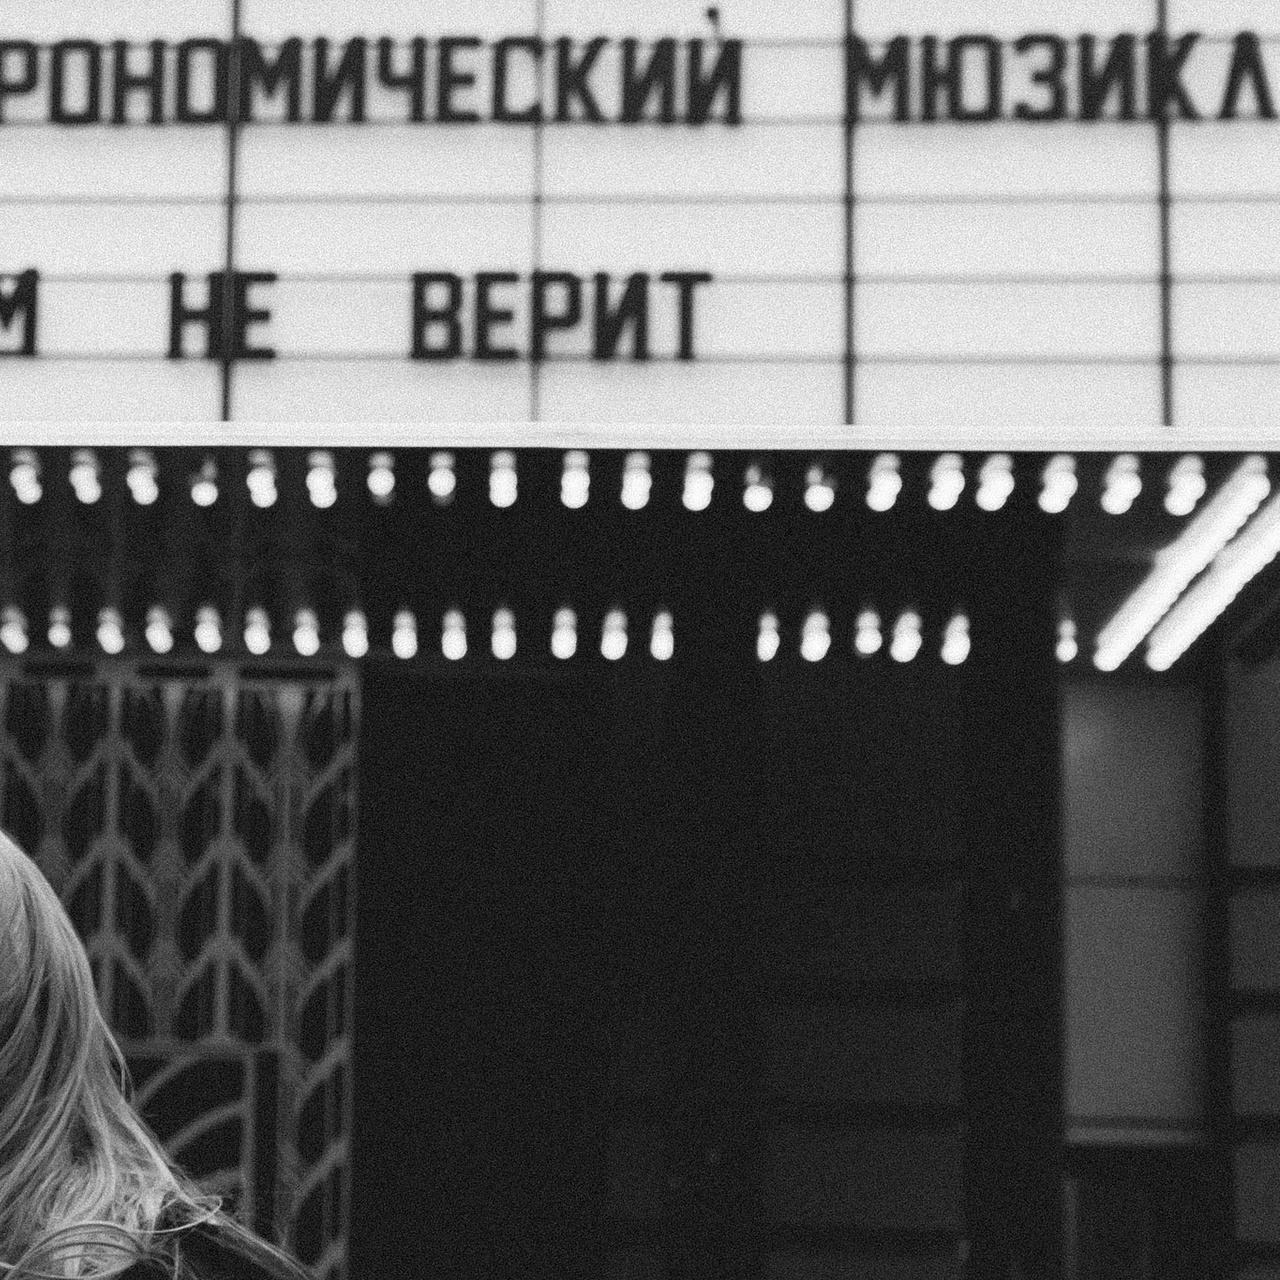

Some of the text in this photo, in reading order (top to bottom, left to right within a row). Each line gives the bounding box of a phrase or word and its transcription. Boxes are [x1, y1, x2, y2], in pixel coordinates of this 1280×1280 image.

[846, 31, 1279, 124] МЮЗИКЛ
[166, 270, 277, 361] НЕ
[410, 269, 713, 363] ВЕРИТ
